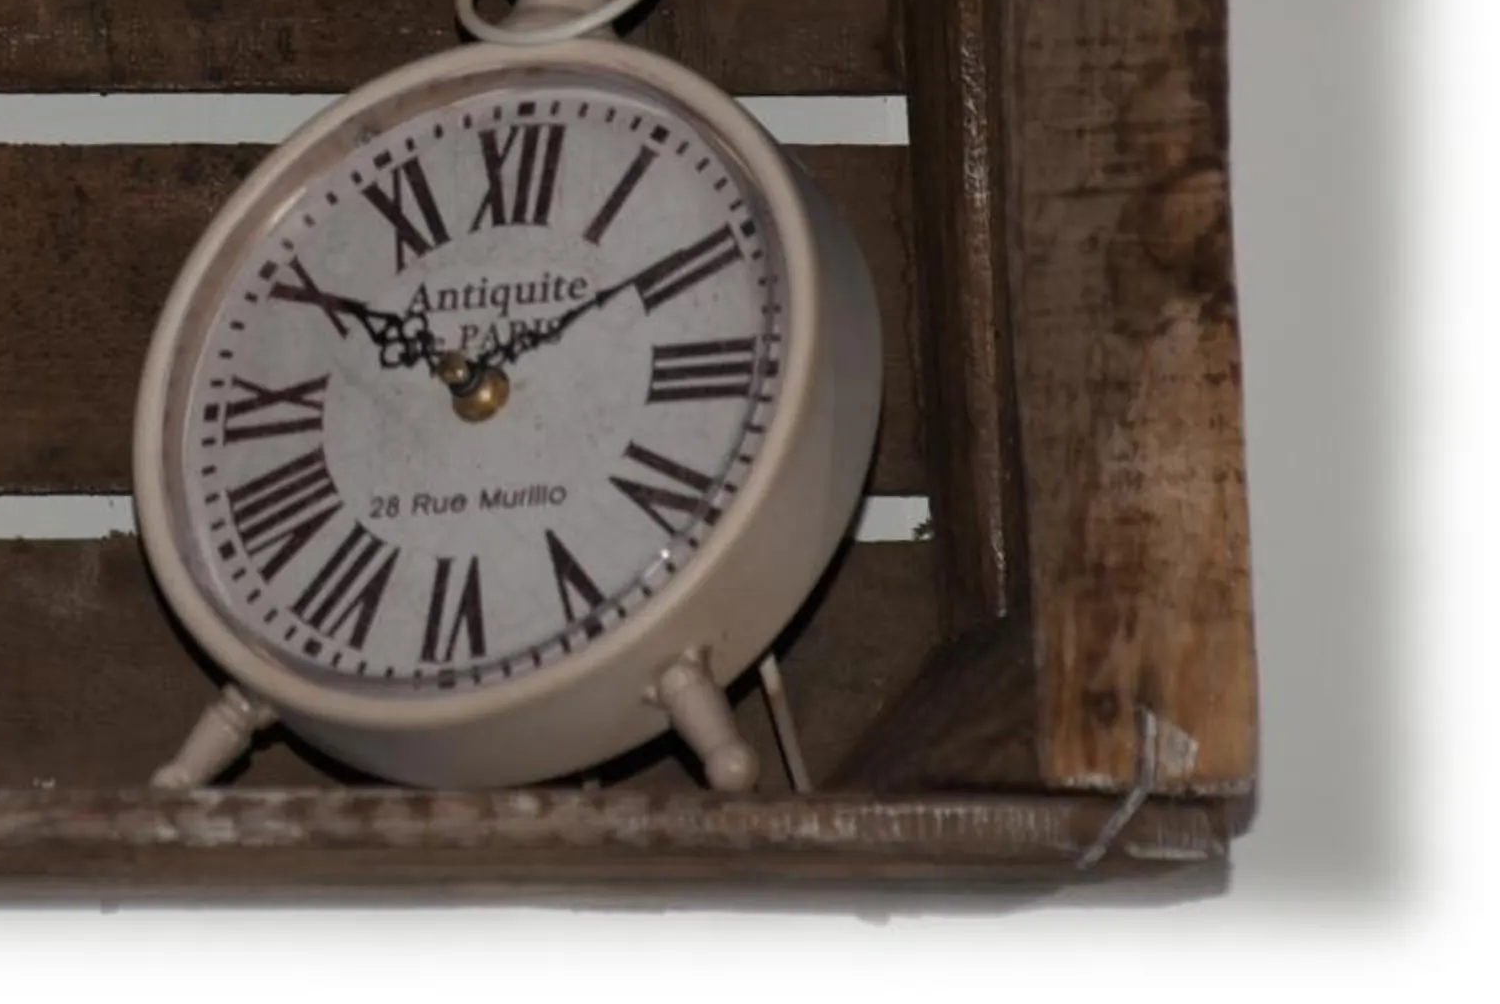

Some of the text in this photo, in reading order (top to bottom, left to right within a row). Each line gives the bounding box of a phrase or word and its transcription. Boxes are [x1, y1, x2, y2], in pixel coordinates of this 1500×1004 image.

[362, 156, 450, 272] XI
[471, 123, 565, 231] XII
[586, 146, 658, 243] I
[270, 260, 350, 336] X
[405, 273, 588, 317] Antiquite
[632, 225, 743, 313] II
[460, 317, 563, 352] PARIS
[649, 339, 756, 403] III
[223, 375, 329, 441] IX
[228, 450, 341, 582] VIII
[369, 485, 567, 518] 28 Rue Murillo
[611, 441, 714, 535] IV
[291, 522, 399, 649] VII
[421, 556, 487, 661] VI
[546, 530, 606, 623] V
